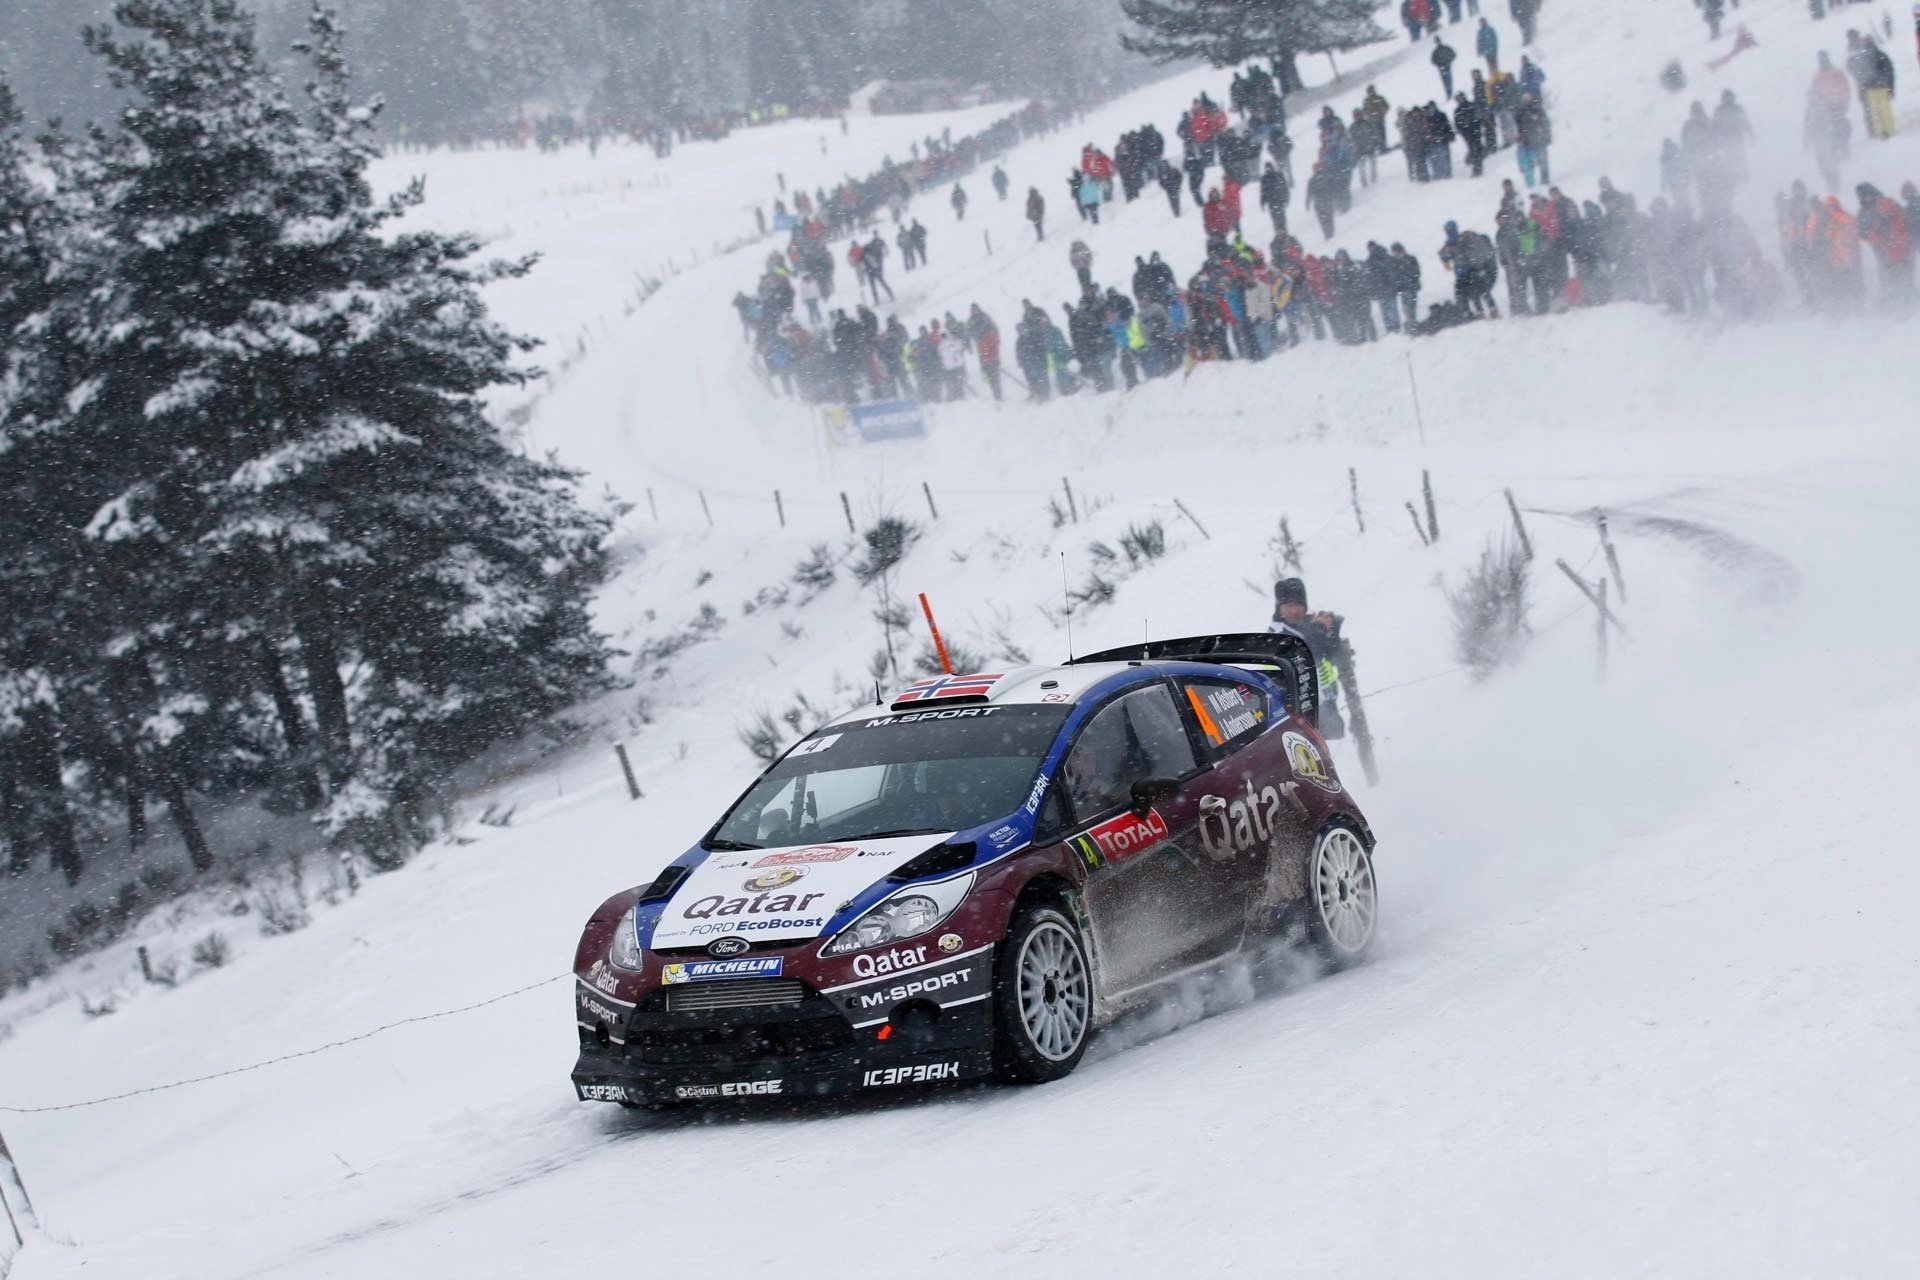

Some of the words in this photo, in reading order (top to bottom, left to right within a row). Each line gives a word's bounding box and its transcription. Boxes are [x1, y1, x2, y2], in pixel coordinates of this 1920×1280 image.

[865, 707, 1001, 728] M-SPORT
[806, 738, 826, 752] 4
[1199, 779, 1313, 861] Qatar
[1077, 837, 1100, 868] 4
[683, 892, 825, 919] Qatar
[689, 922, 735, 936] FORD
[736, 917, 824, 931] EcoBoost
[715, 941, 739, 953] Ford
[832, 942, 862, 952] PIAA
[691, 959, 780, 975] MICHELIN
[852, 945, 927, 977] Qatar
[596, 965, 620, 995] Qatar
[861, 968, 972, 1009] M-SPORT
[687, 1085, 719, 1097] Castrol
[721, 1079, 783, 1096] EDGE
